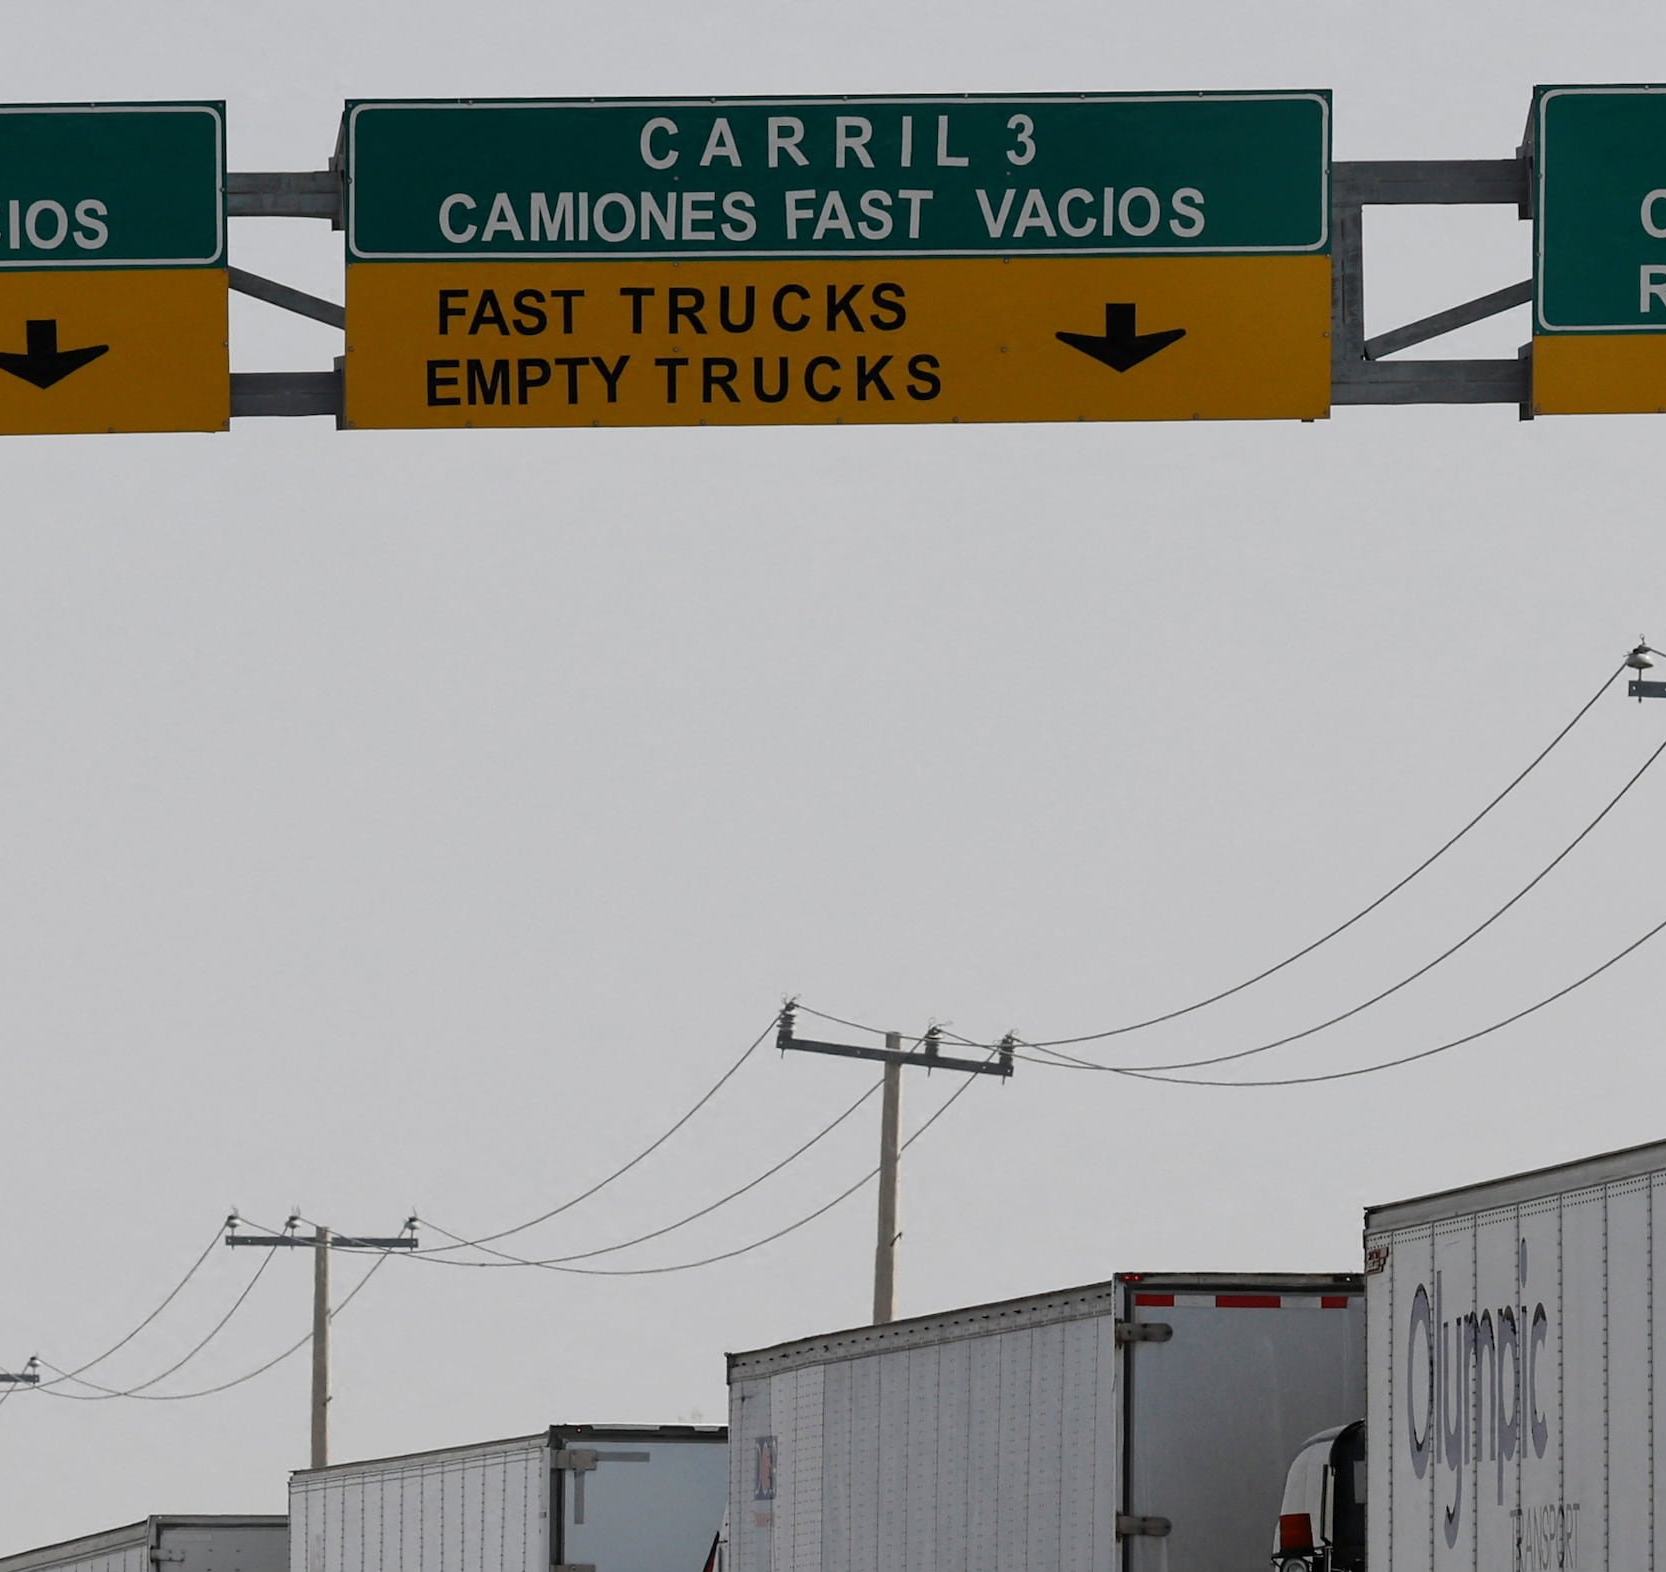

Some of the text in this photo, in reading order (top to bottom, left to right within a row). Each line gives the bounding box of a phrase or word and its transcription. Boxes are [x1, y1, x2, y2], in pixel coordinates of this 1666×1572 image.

[641, 114, 1035, 169] CARRIL 3
[440, 188, 1204, 243] CAMIONES FAST VACIOS
[439, 283, 906, 336] FAST TRUCKS
[427, 354, 941, 406] EMPTY TRUCKS
[1407, 1237, 1548, 1549] Olympic
